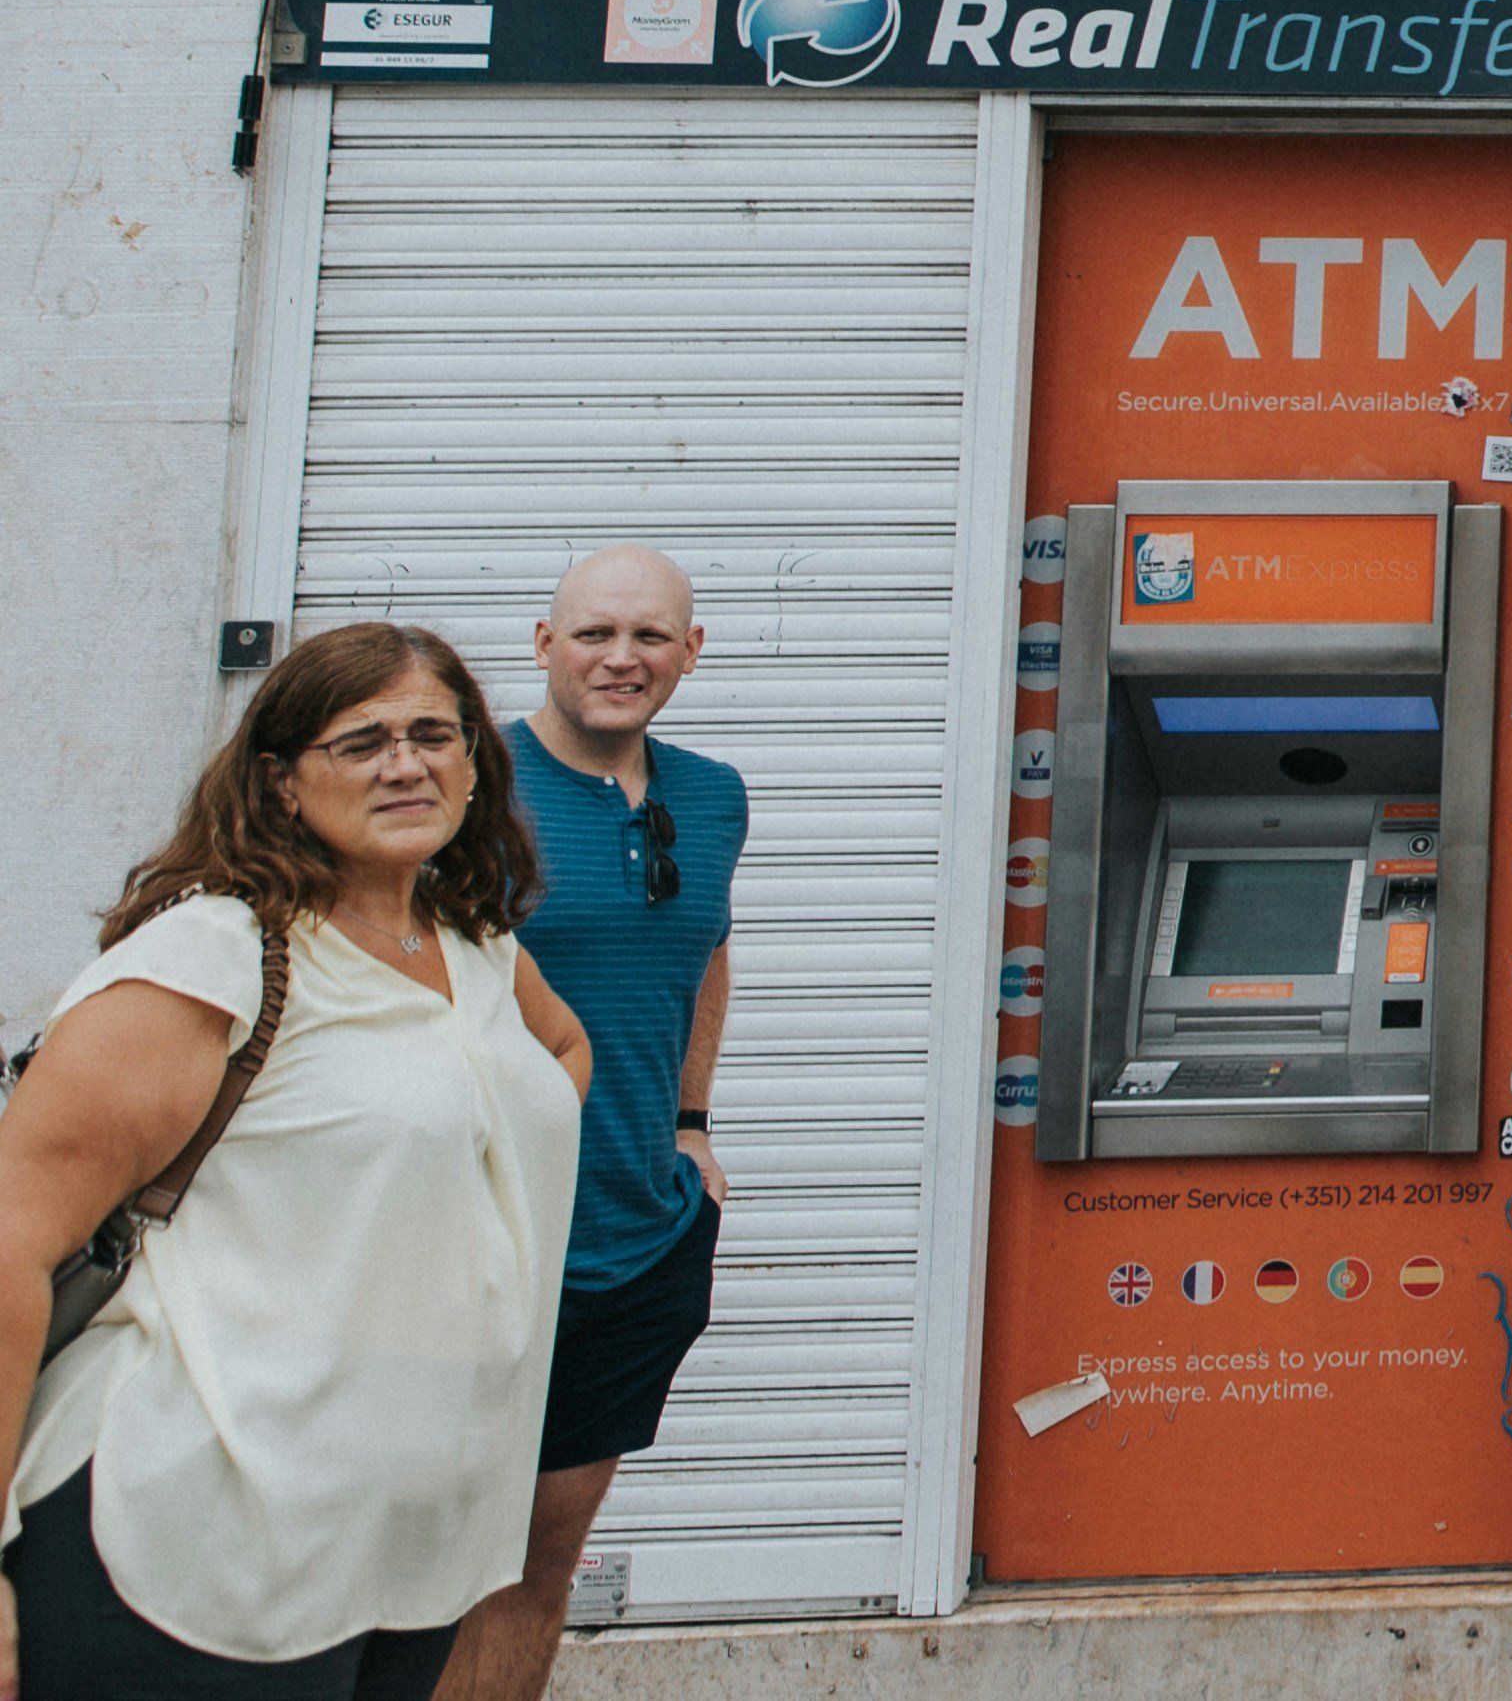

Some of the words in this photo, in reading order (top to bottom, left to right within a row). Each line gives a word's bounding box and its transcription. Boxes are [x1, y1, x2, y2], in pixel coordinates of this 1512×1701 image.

[393, 13, 453, 28] ESEGUR
[632, 16, 691, 27] MoneyGram
[1128, 235, 1508, 361] ATM
[1029, 645, 1053, 655] VISA
[1063, 1188, 1181, 1213] Customer
[1187, 1186, 1273, 1210] Service
[1279, 1184, 1352, 1210] (+351)
[1358, 1183, 1397, 1206] 214
[1403, 1182, 1443, 1205] 201
[1449, 1176, 1494, 1204] 997
[1076, 1352, 1178, 1378] Express
[1185, 1347, 1270, 1372] access
[1278, 1348, 1305, 1371] to
[1313, 1350, 1371, 1372] your
[1379, 1347, 1467, 1369] money.
[1220, 1379, 1334, 1405] Anytime.
